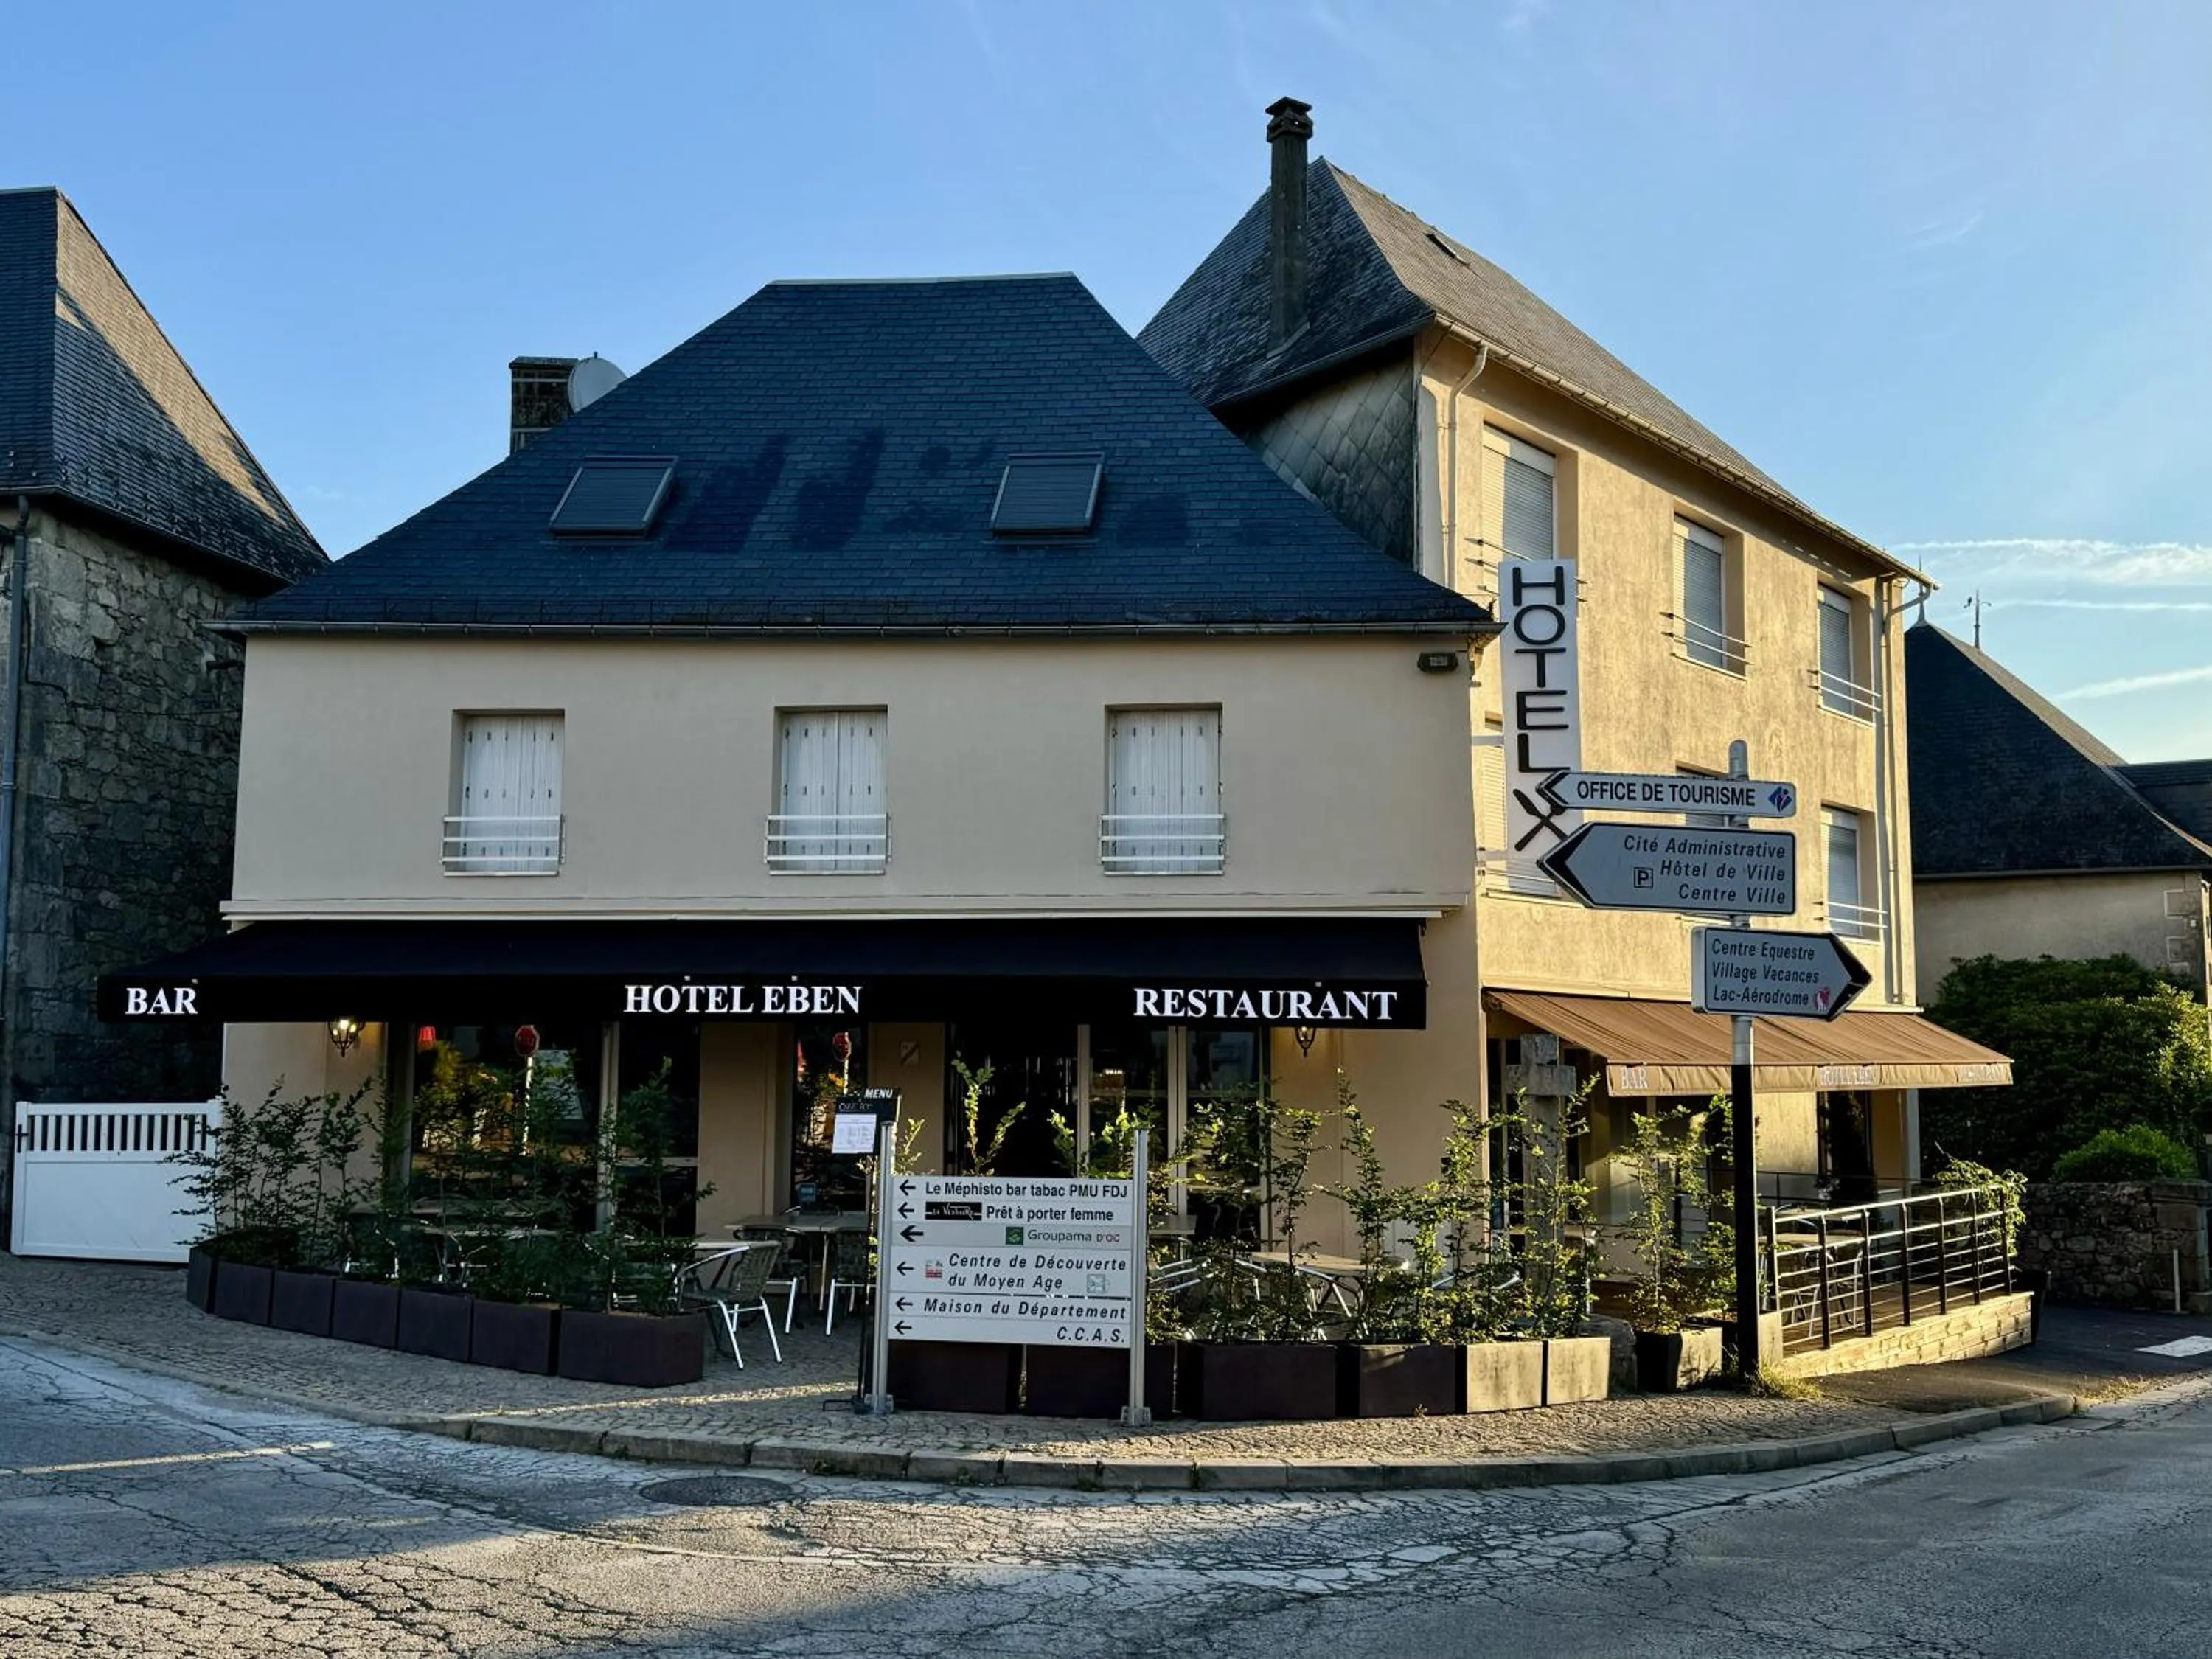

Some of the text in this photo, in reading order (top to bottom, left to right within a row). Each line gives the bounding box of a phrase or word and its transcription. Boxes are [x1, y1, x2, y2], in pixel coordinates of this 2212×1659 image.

[1512, 566, 1571, 774] HOTEL
[1578, 781, 1755, 806] OFFICE DE TOURISME
[1624, 835, 1784, 858] Cité Administrative
[1660, 860, 1784, 880] Hôtel de Ville
[1679, 884, 1785, 904] Centre Ville
[1712, 939, 1814, 961] Centre Equestre
[1713, 962, 1819, 983] Village Vacances
[125, 988, 198, 1014] BAR
[624, 985, 861, 1013] HOTEL EBEN
[1134, 989, 1397, 1019] RESTAURANT
[1714, 985, 1808, 1005] Lac-Aérodrome
[1620, 1066, 1648, 1089] BAR
[864, 1088, 893, 1099] MENU
[926, 1183, 1127, 1197] Le Méphisto bar tabac PMU FDJ
[987, 1206, 1113, 1222] Prêt à porter femme
[1028, 1230, 1091, 1242] Groupama
[950, 1253, 1125, 1270] Centre de Découverte
[949, 1273, 1062, 1292] du Moyen Age
[925, 1298, 1125, 1319] Maison du Département
[1057, 1327, 1124, 1342] C.C.A.S.
